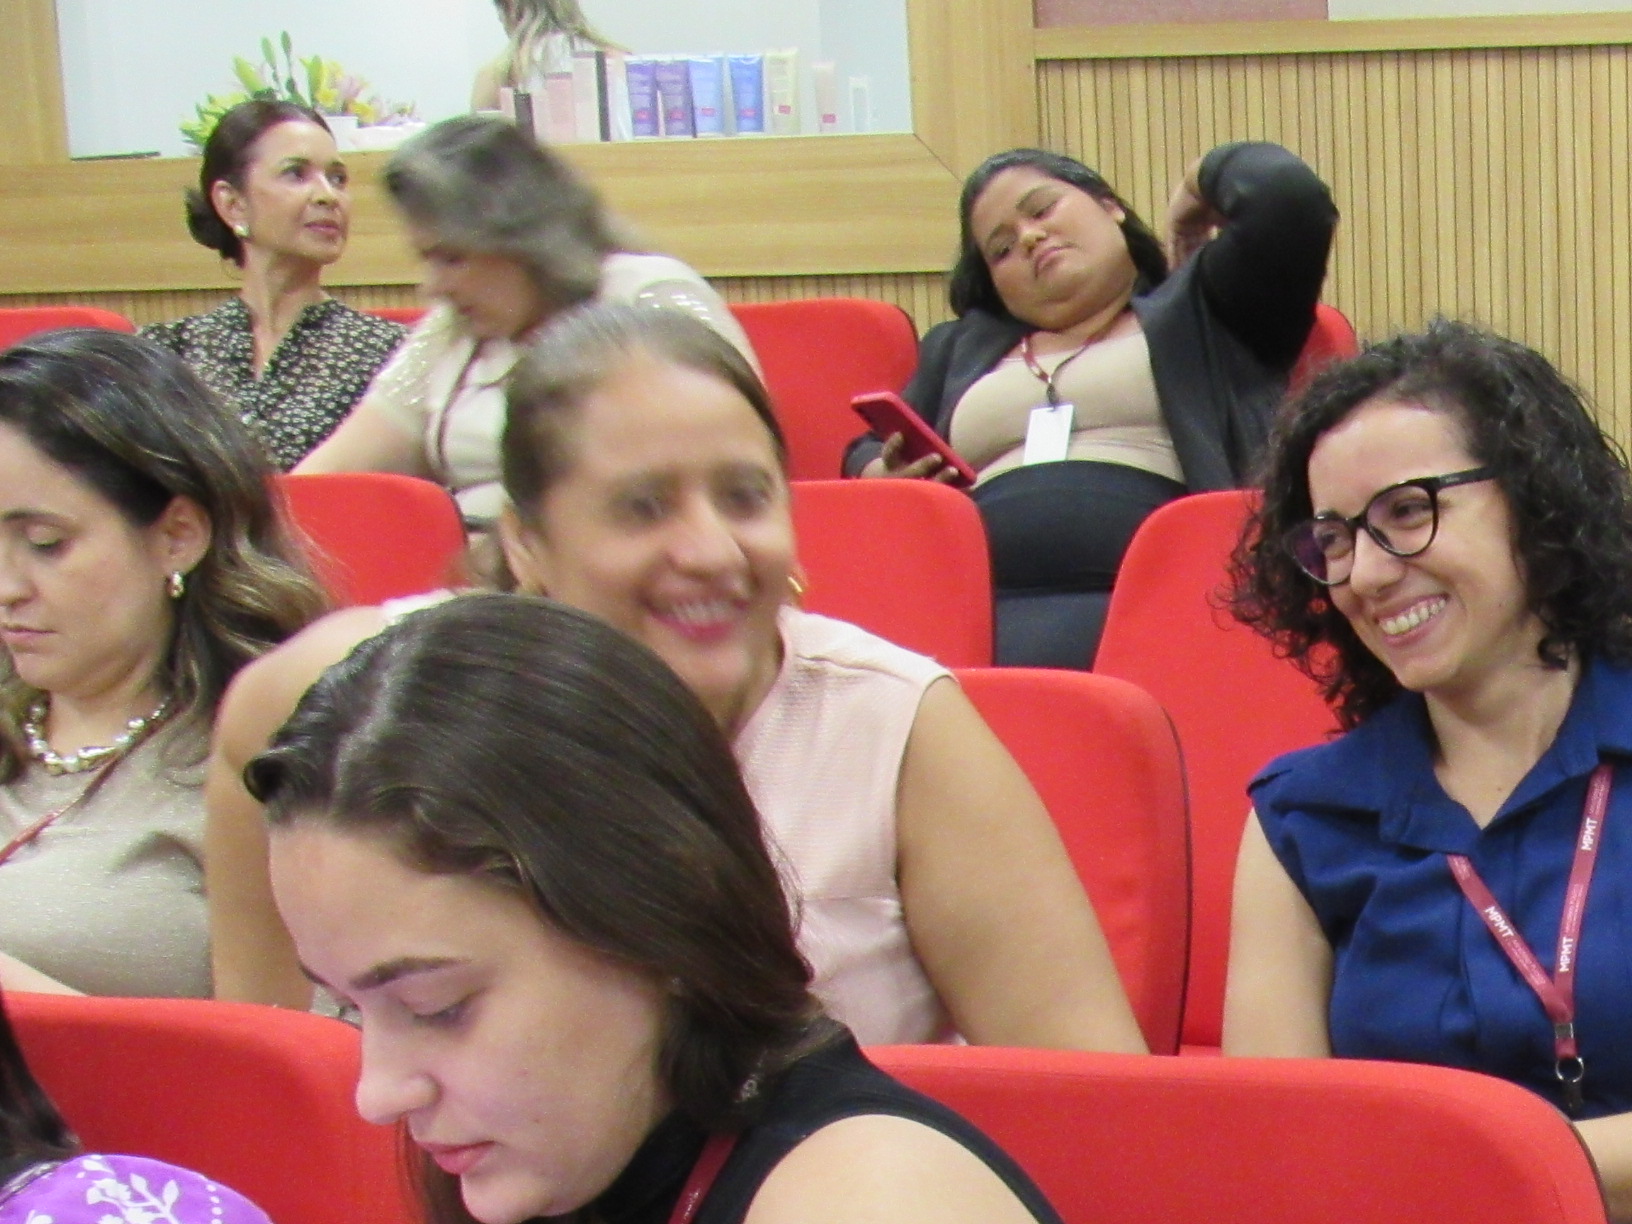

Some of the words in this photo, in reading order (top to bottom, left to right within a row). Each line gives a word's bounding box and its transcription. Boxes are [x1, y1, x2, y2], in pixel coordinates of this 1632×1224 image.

[1581, 817, 1598, 851] MPMT
[1484, 905, 1515, 938] MPMT
[1559, 936, 1574, 973] MPMT
